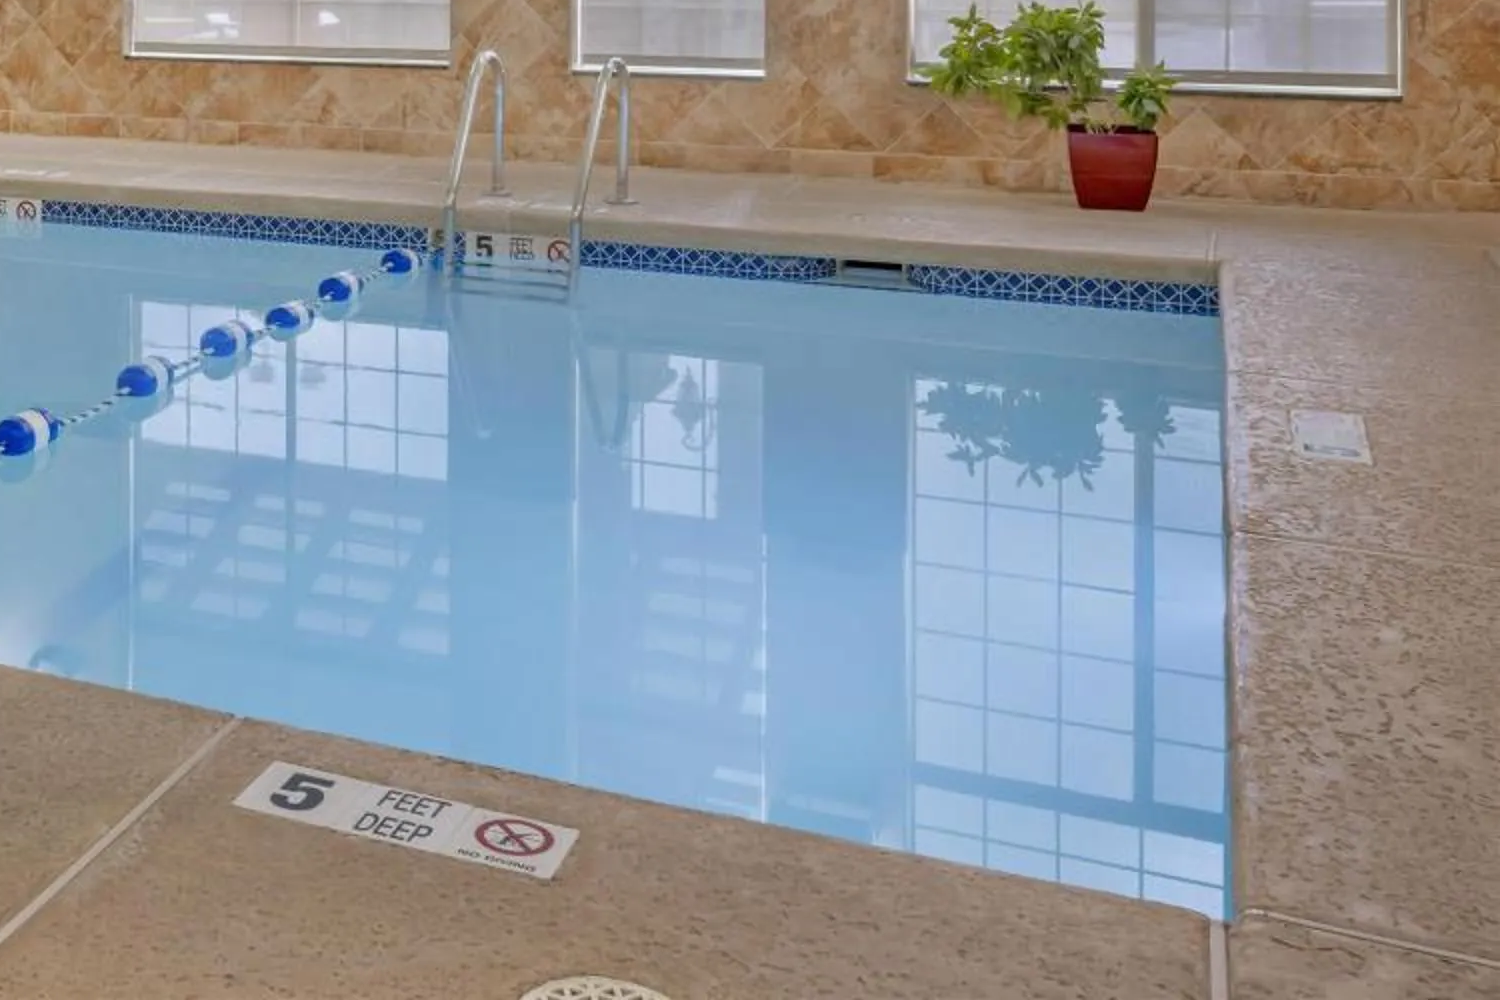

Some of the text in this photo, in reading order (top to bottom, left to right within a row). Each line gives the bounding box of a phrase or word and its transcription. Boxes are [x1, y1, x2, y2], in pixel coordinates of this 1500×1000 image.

[475, 235, 493, 257] 5
[269, 772, 336, 811] 5
[376, 790, 453, 819] FEET
[353, 811, 434, 842] DEEP
